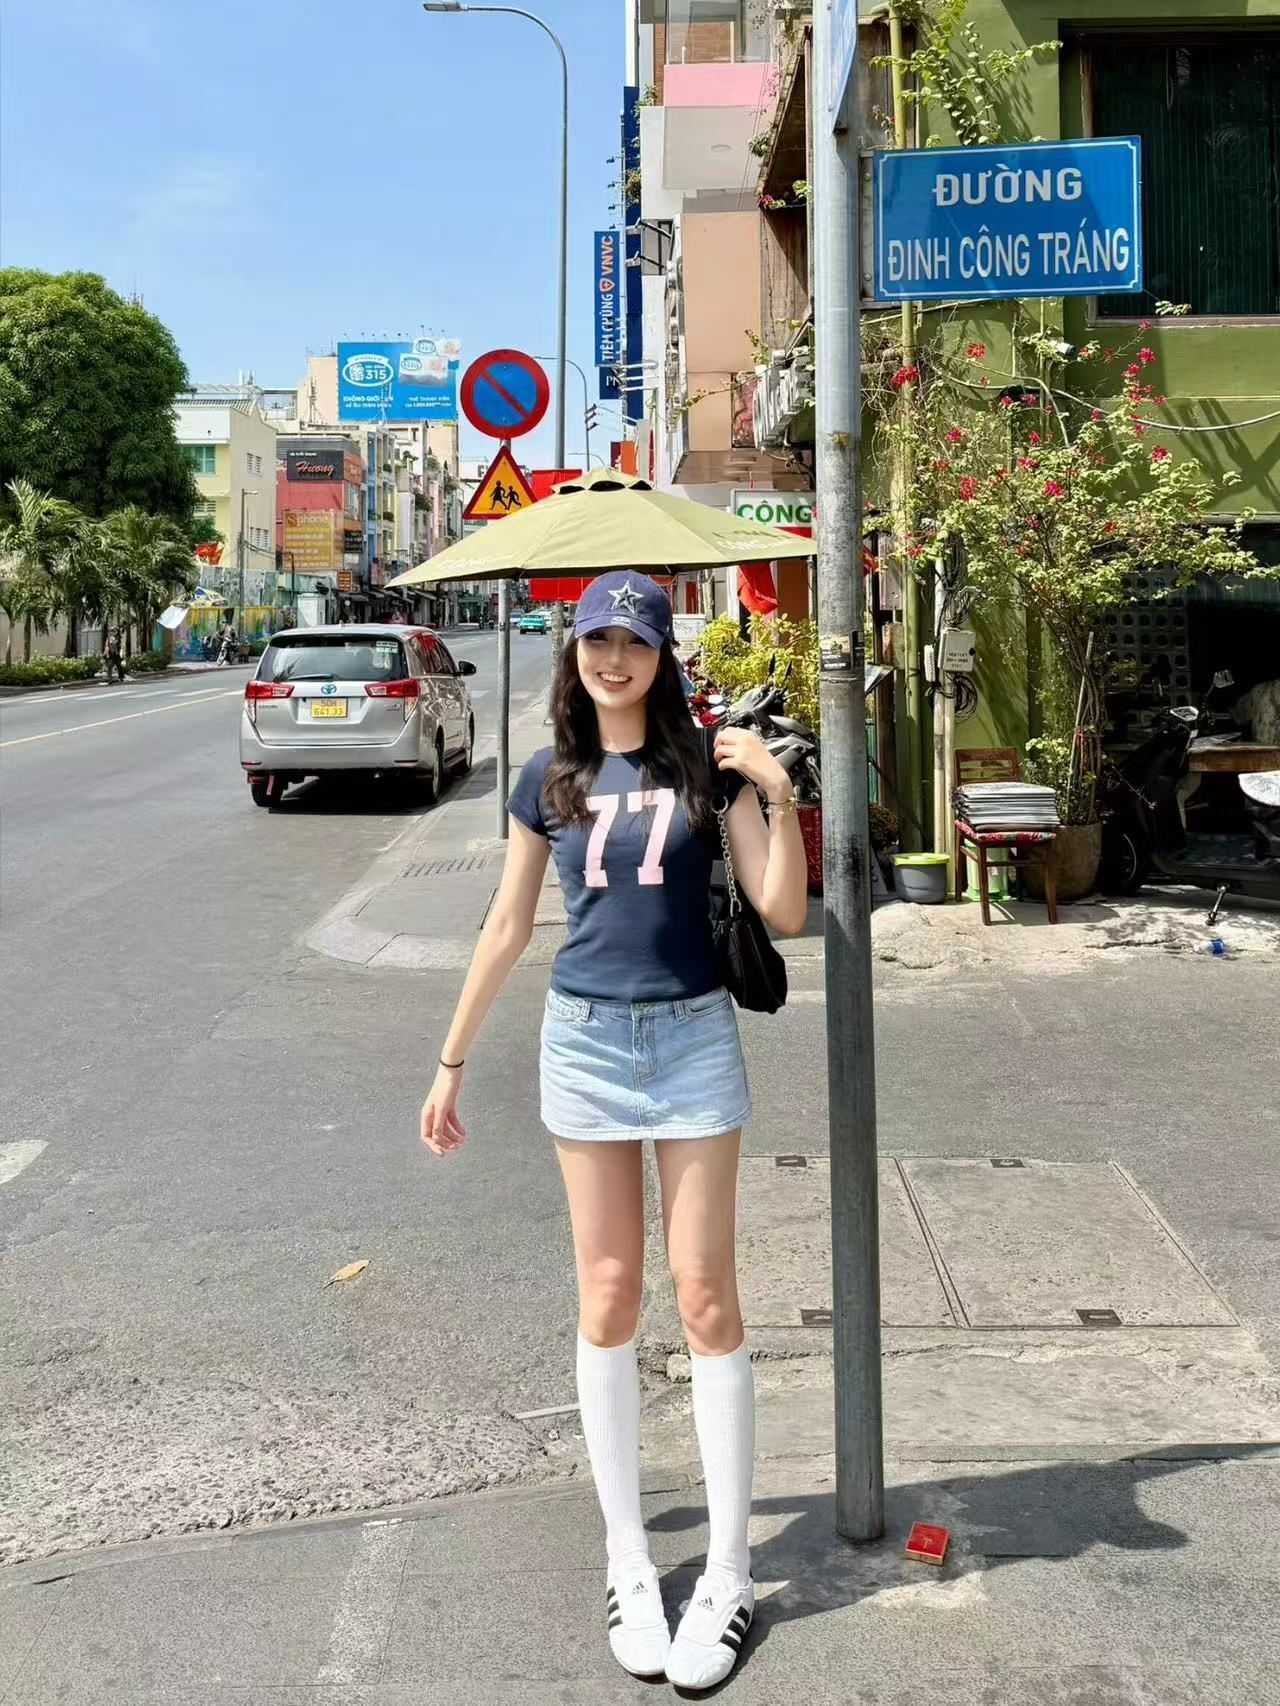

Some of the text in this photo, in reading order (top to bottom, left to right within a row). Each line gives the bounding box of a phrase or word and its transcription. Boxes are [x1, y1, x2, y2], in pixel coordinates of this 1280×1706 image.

[931, 163, 1083, 208] ĐƯỜNG
[601, 235, 614, 276] VNVC
[887, 217, 1130, 282] ĐINH CÔNG TRÁNG
[365, 369, 387, 380] 315
[582, 788, 676, 887] 77
